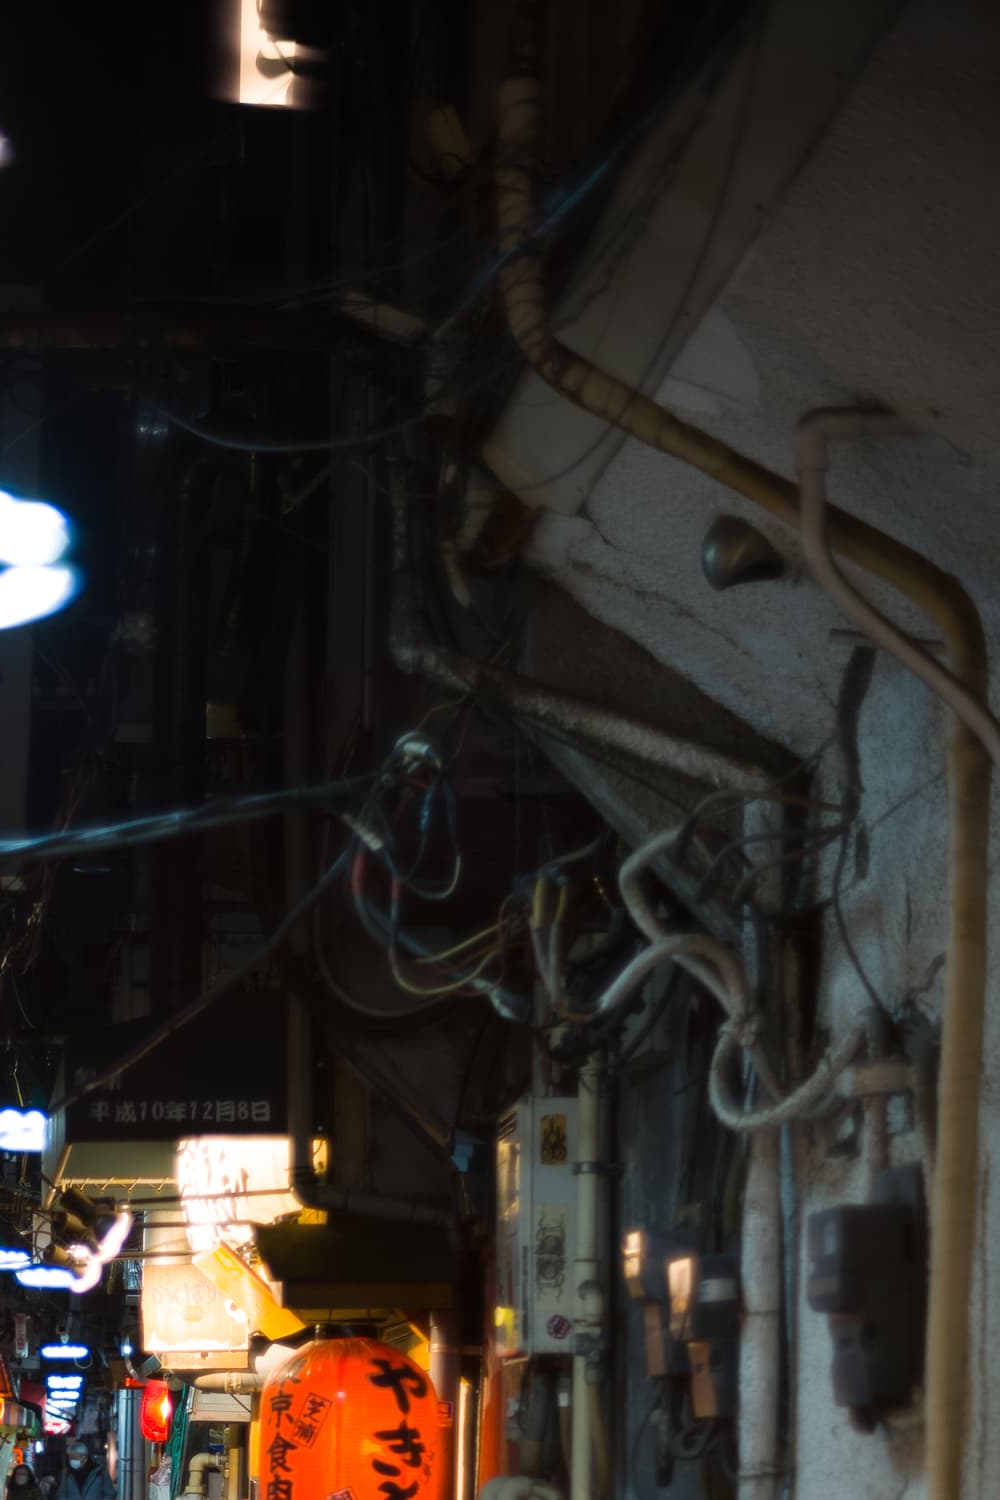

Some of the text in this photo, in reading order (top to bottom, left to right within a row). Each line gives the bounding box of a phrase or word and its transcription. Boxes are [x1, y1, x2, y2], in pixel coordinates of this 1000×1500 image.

[88, 1099, 271, 1123] 平成10年12月8日
